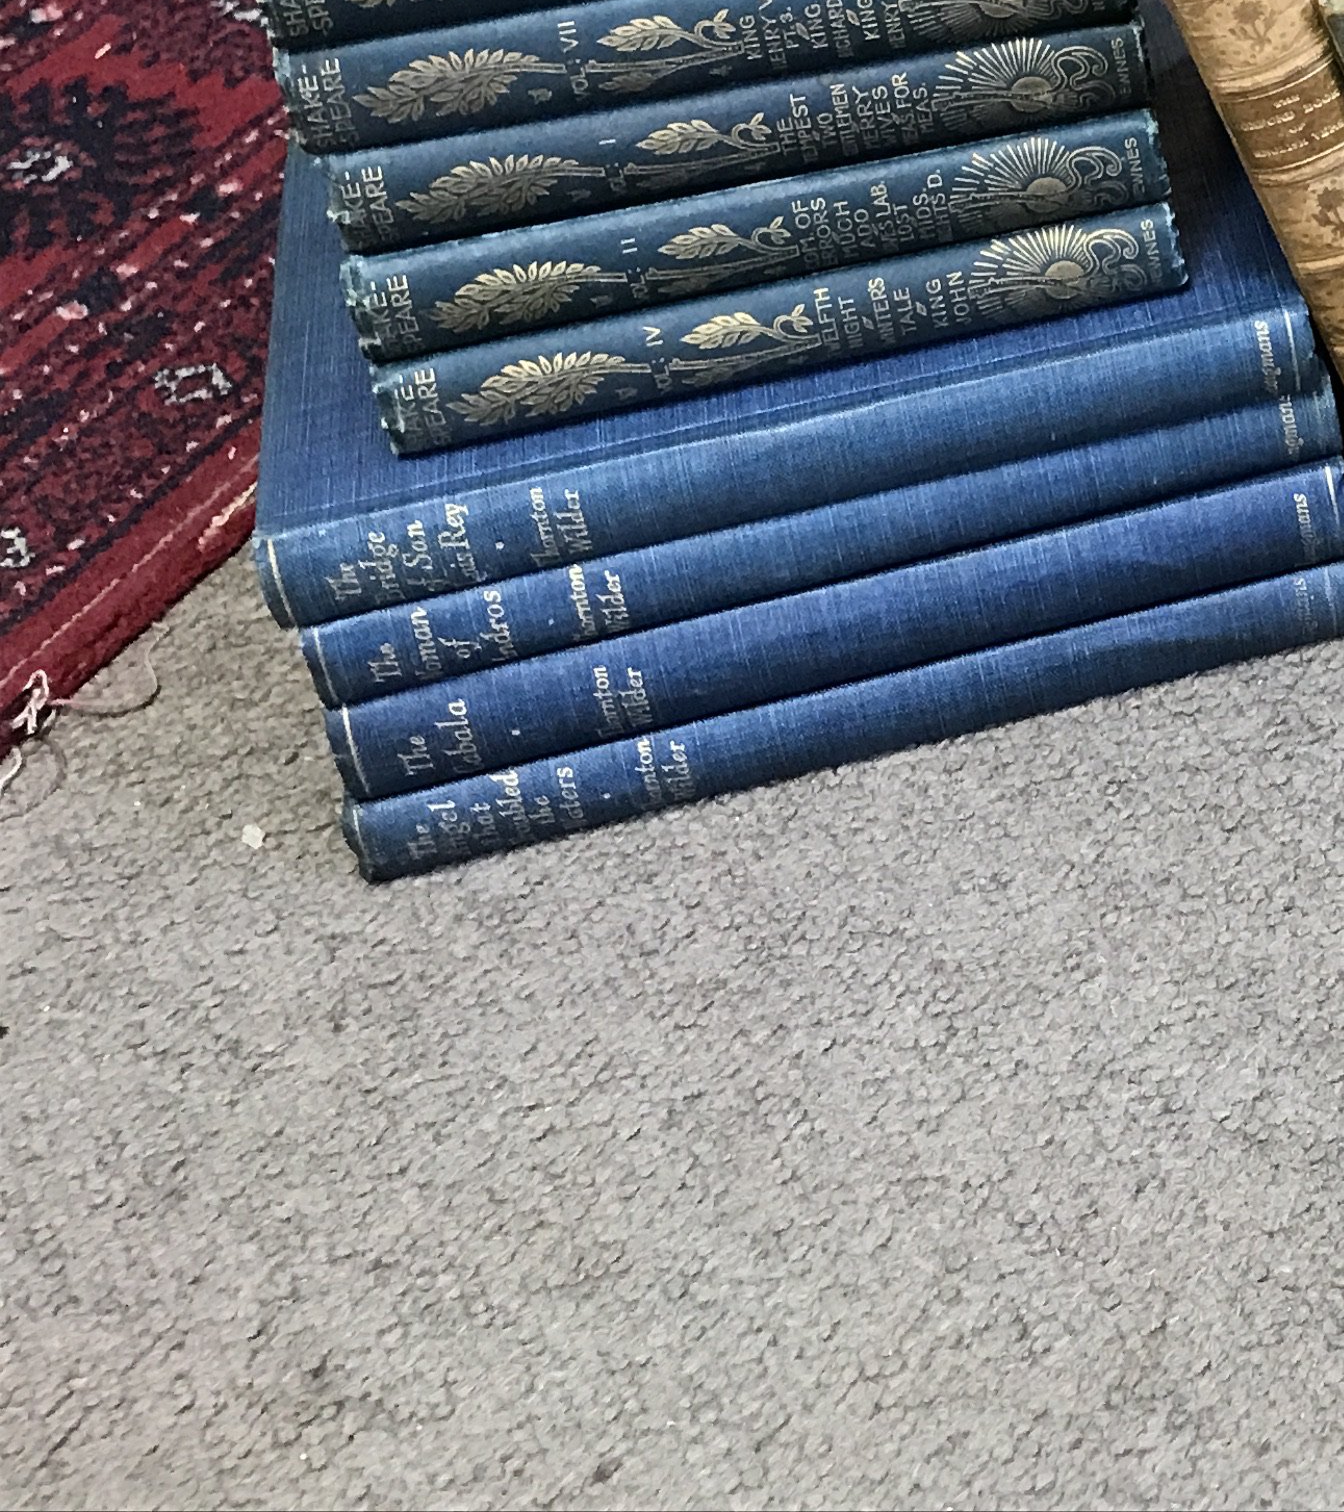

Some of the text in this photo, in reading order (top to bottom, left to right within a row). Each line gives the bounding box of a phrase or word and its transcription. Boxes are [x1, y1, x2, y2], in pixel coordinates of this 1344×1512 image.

[557, 20, 578, 52] VII
[740, 15, 761, 60] KING
[804, 2, 829, 48] KING
[891, 71, 913, 109] FOR
[776, 115, 797, 156] THE
[816, 112, 838, 148] TWO
[852, 85, 880, 148] MERRY
[791, 199, 811, 229] OF
[833, 200, 859, 258] MUCH
[853, 209, 876, 247] ADO
[893, 203, 915, 242] LOST
[622, 236, 637, 255] II
[893, 287, 917, 336] TALE
[926, 278, 949, 328] KING
[946, 270, 971, 325] JOHN
[642, 326, 663, 347] IV
[838, 296, 863, 348] NIGHT
[438, 503, 469, 550] Rey
[529, 487, 560, 567] Thornton
[553, 488, 592, 553] Wilder
[402, 519, 433, 570] San
[325, 562, 362, 601] The
[595, 569, 630, 632] Wilder
[368, 643, 402, 682] The
[437, 636, 482, 658] of
[618, 667, 652, 728] Wilder
[397, 735, 434, 776] The
[433, 698, 484, 774] Cabala
